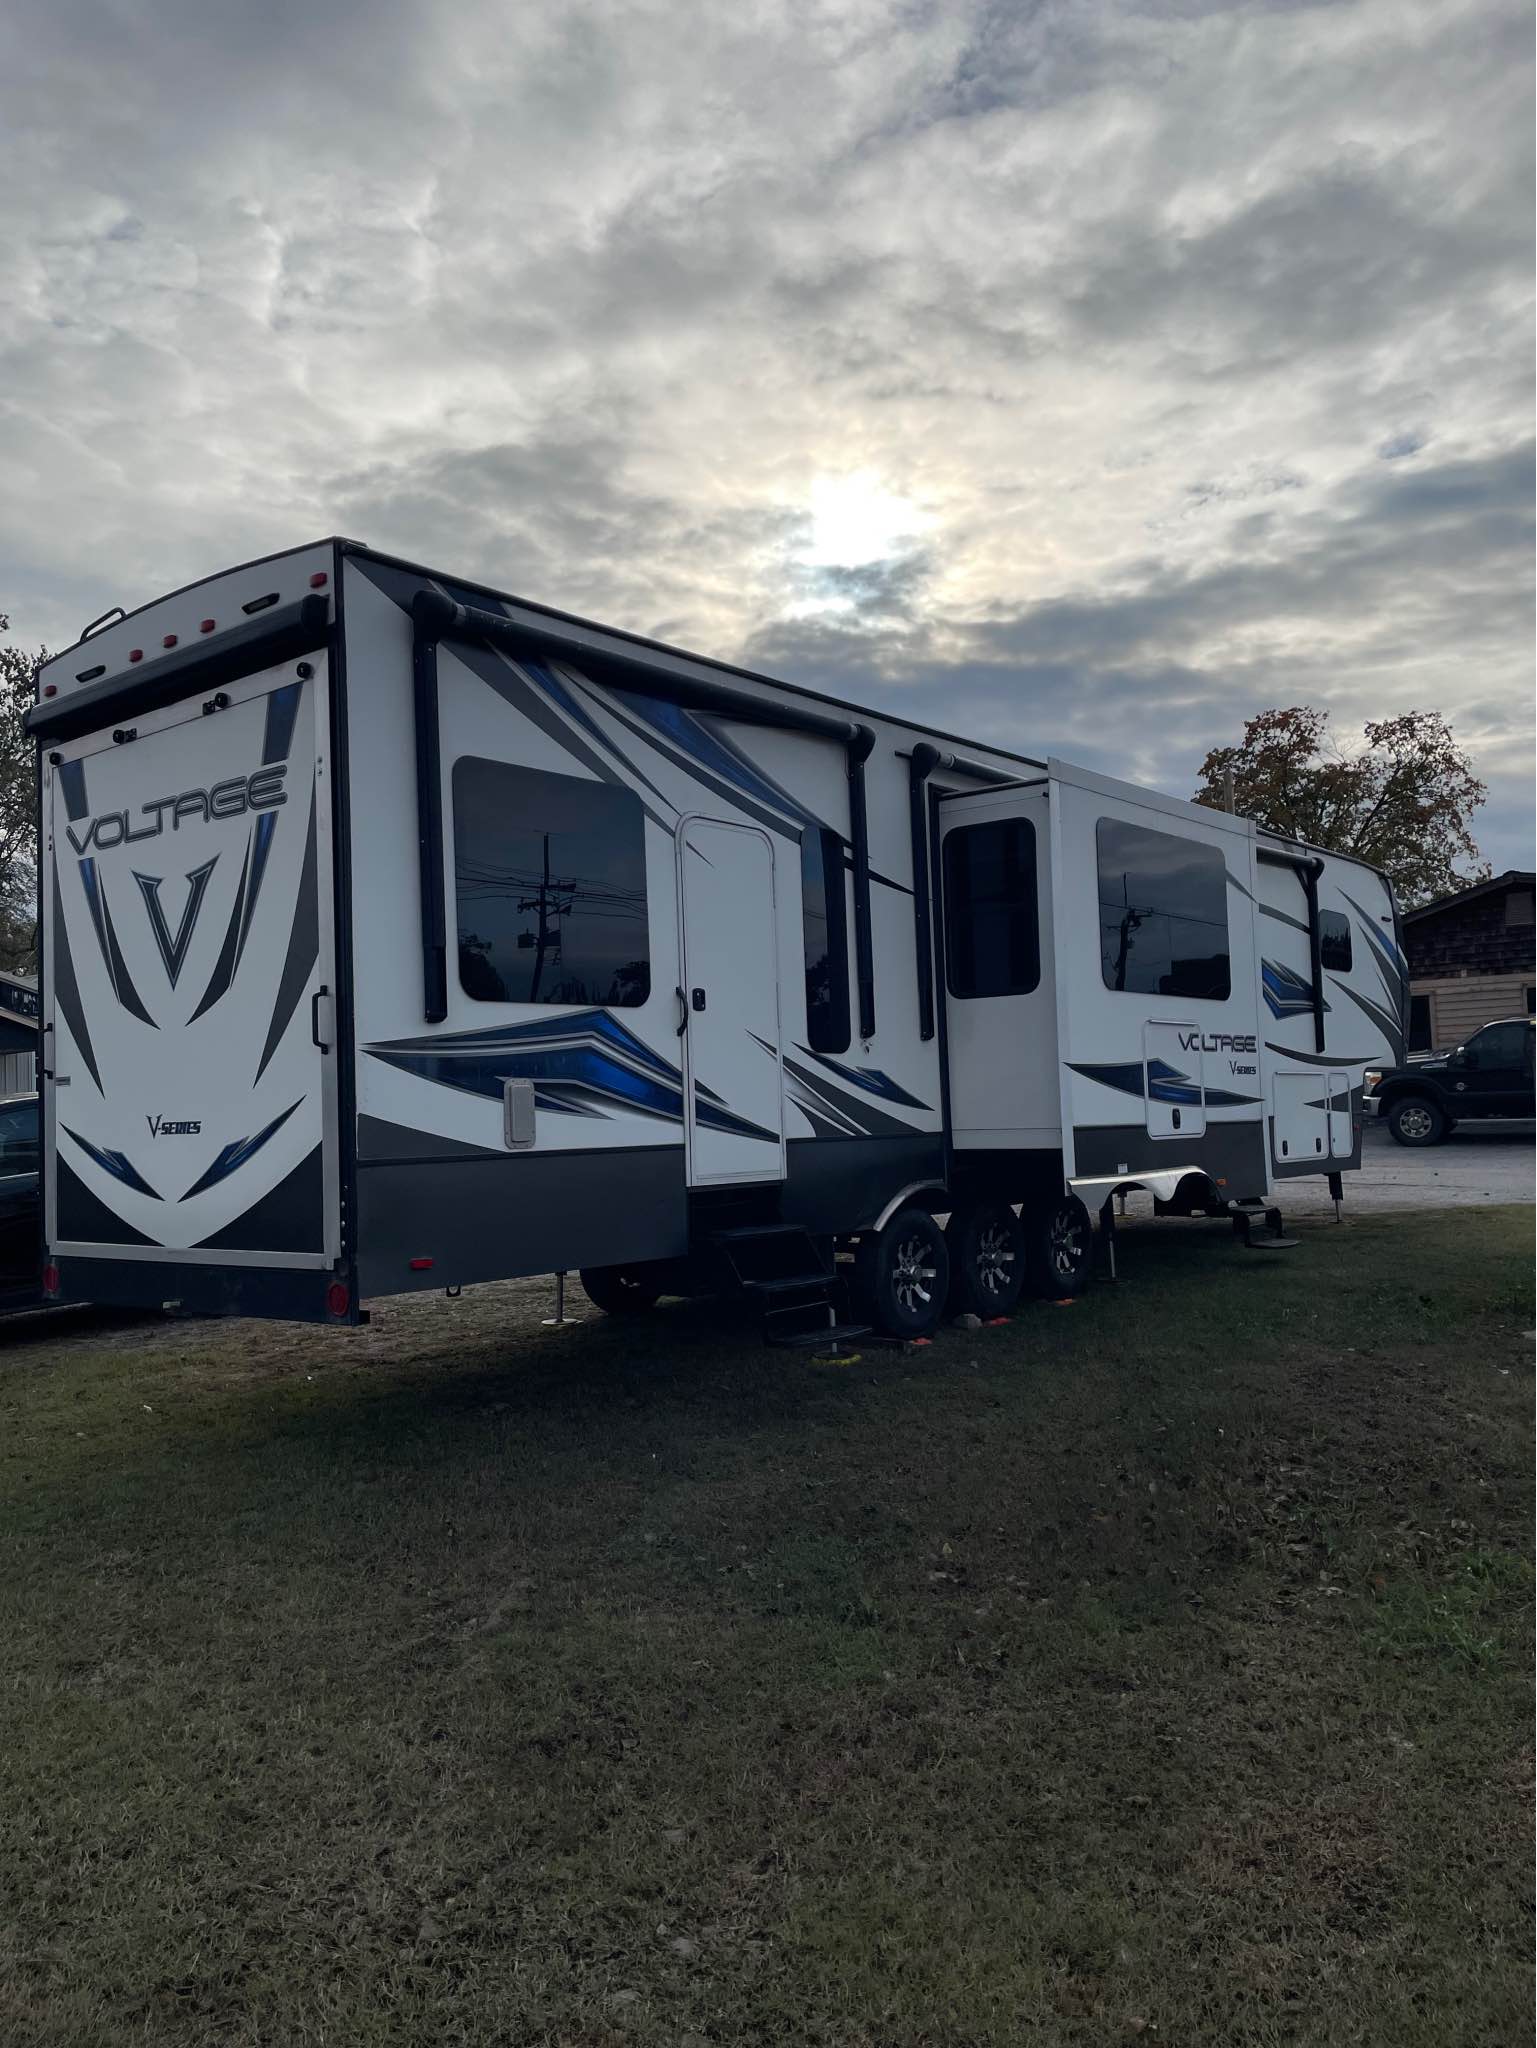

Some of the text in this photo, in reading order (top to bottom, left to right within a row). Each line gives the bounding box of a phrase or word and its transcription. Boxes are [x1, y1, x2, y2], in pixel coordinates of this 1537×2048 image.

[66, 764, 287, 855] VOLTAGE
[132, 854, 220, 991] V
[1178, 1032, 1257, 1053] VOLTAGE
